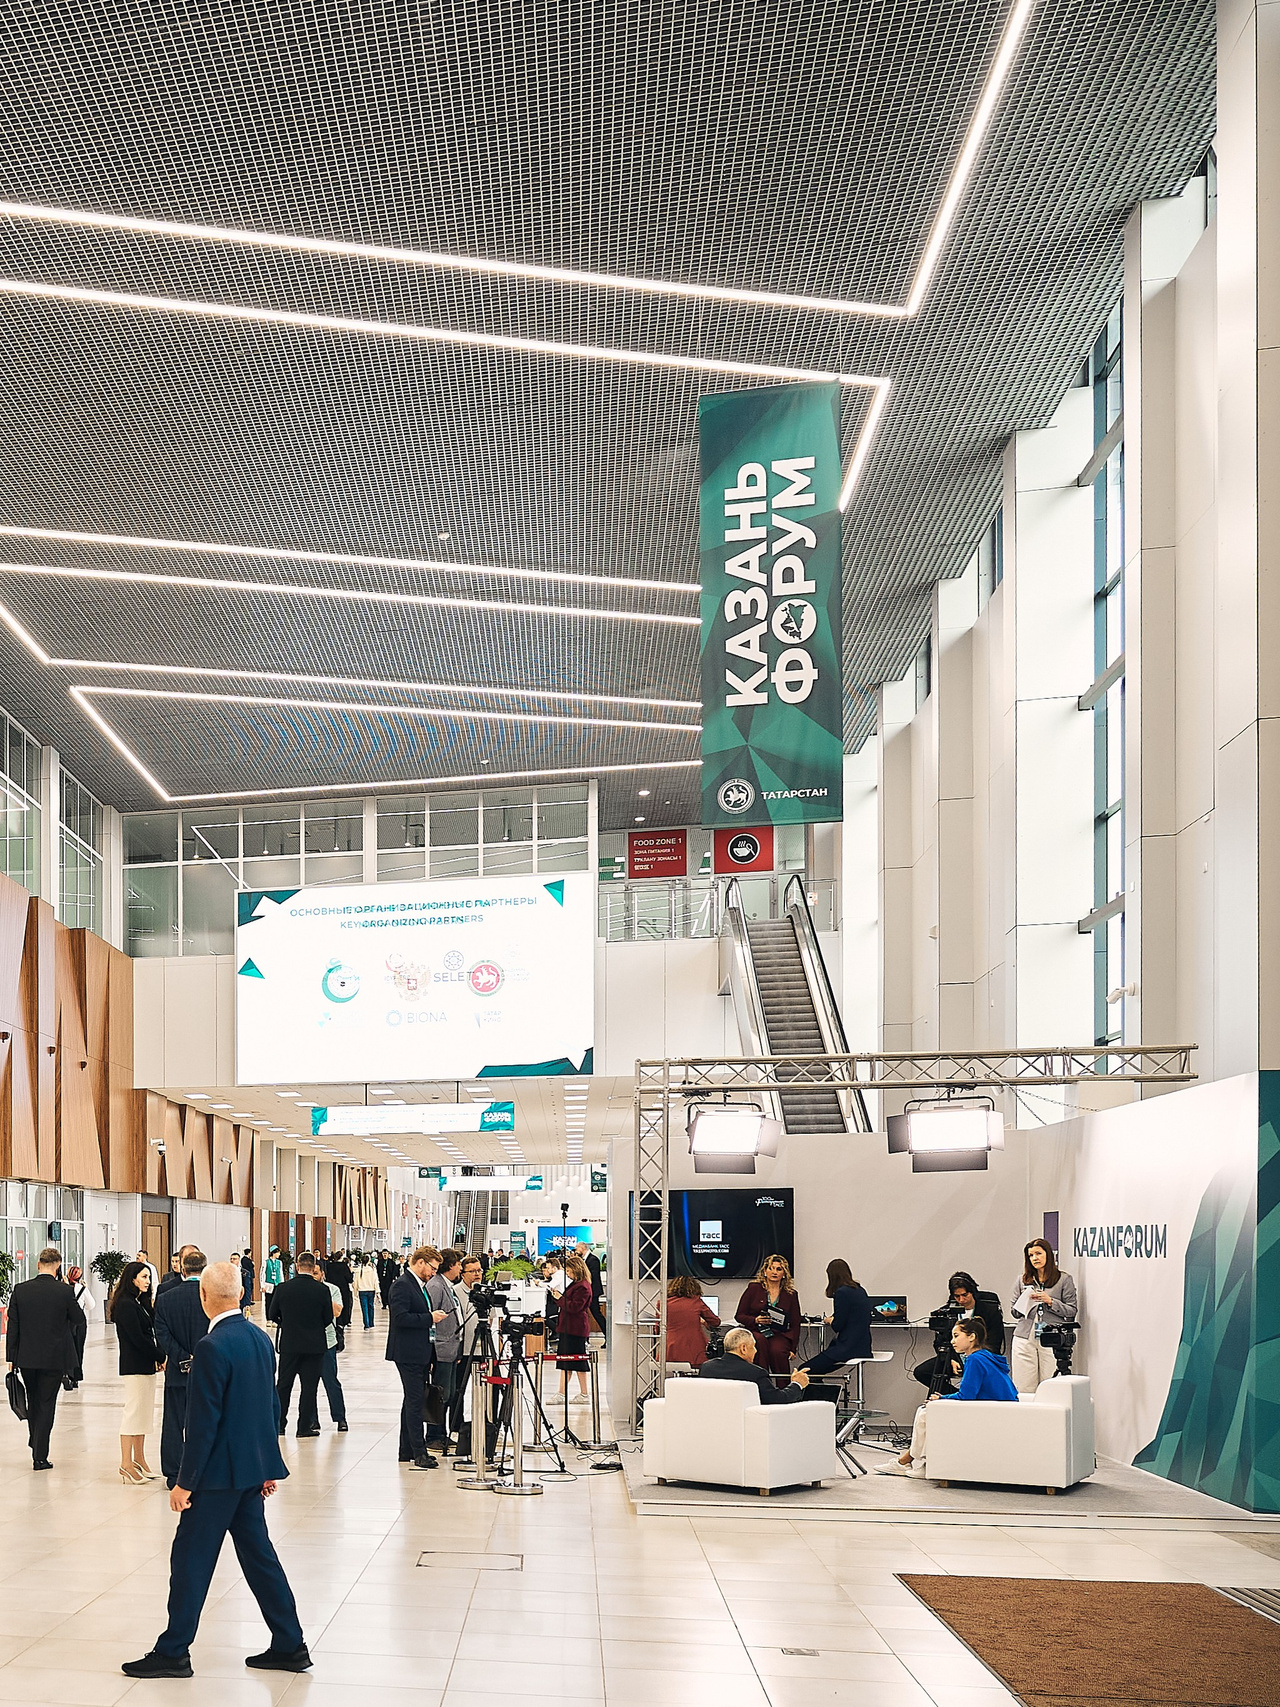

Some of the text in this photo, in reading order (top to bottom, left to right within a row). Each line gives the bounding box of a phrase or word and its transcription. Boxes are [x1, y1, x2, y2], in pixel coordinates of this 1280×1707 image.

[724, 462, 768, 708] КАЗАНЬ
[771, 456, 818, 704] ФОРУМ
[761, 788, 828, 800] ТАТАРСТАН
[1073, 1223, 1167, 1258] KAZANFORUM
